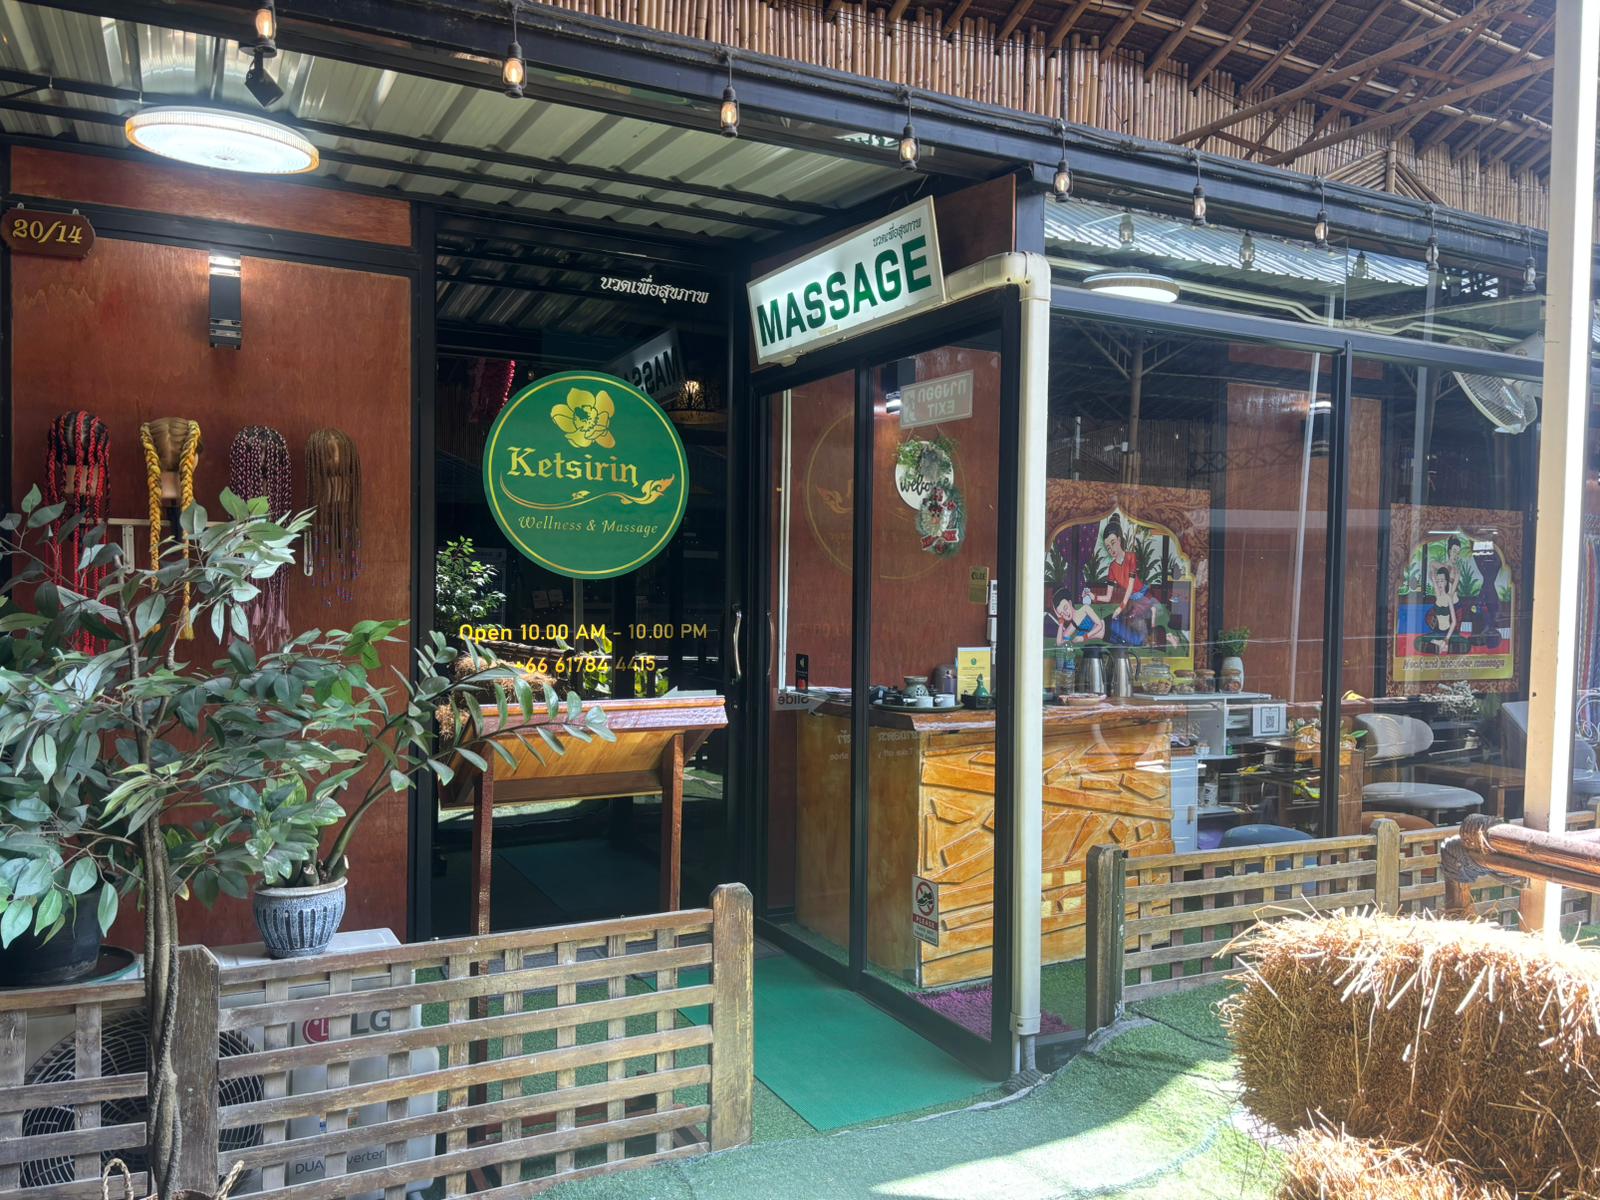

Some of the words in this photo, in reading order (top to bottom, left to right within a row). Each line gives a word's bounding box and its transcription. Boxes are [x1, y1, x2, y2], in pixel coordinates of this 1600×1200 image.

[12, 219, 83, 244] 20/14
[600, 274, 710, 304] นวดเพื่อสุขภาพ
[756, 235, 932, 347] MASSAGE
[506, 446, 639, 487] Ketsirin
[518, 515, 582, 532] Wellness
[586, 519, 597, 532] &
[601, 519, 658, 538] Massage
[459, 624, 512, 645] Open
[520, 624, 569, 641] 10.00
[575, 624, 606, 640] AM
[628, 623, 674, 640] 10.00
[680, 623, 707, 639] PM
[555, 656, 609, 673] 61784
[615, 655, 656, 672] 4415
[350, 1009, 391, 1035] LG
[295, 1159, 325, 1175] DUA
